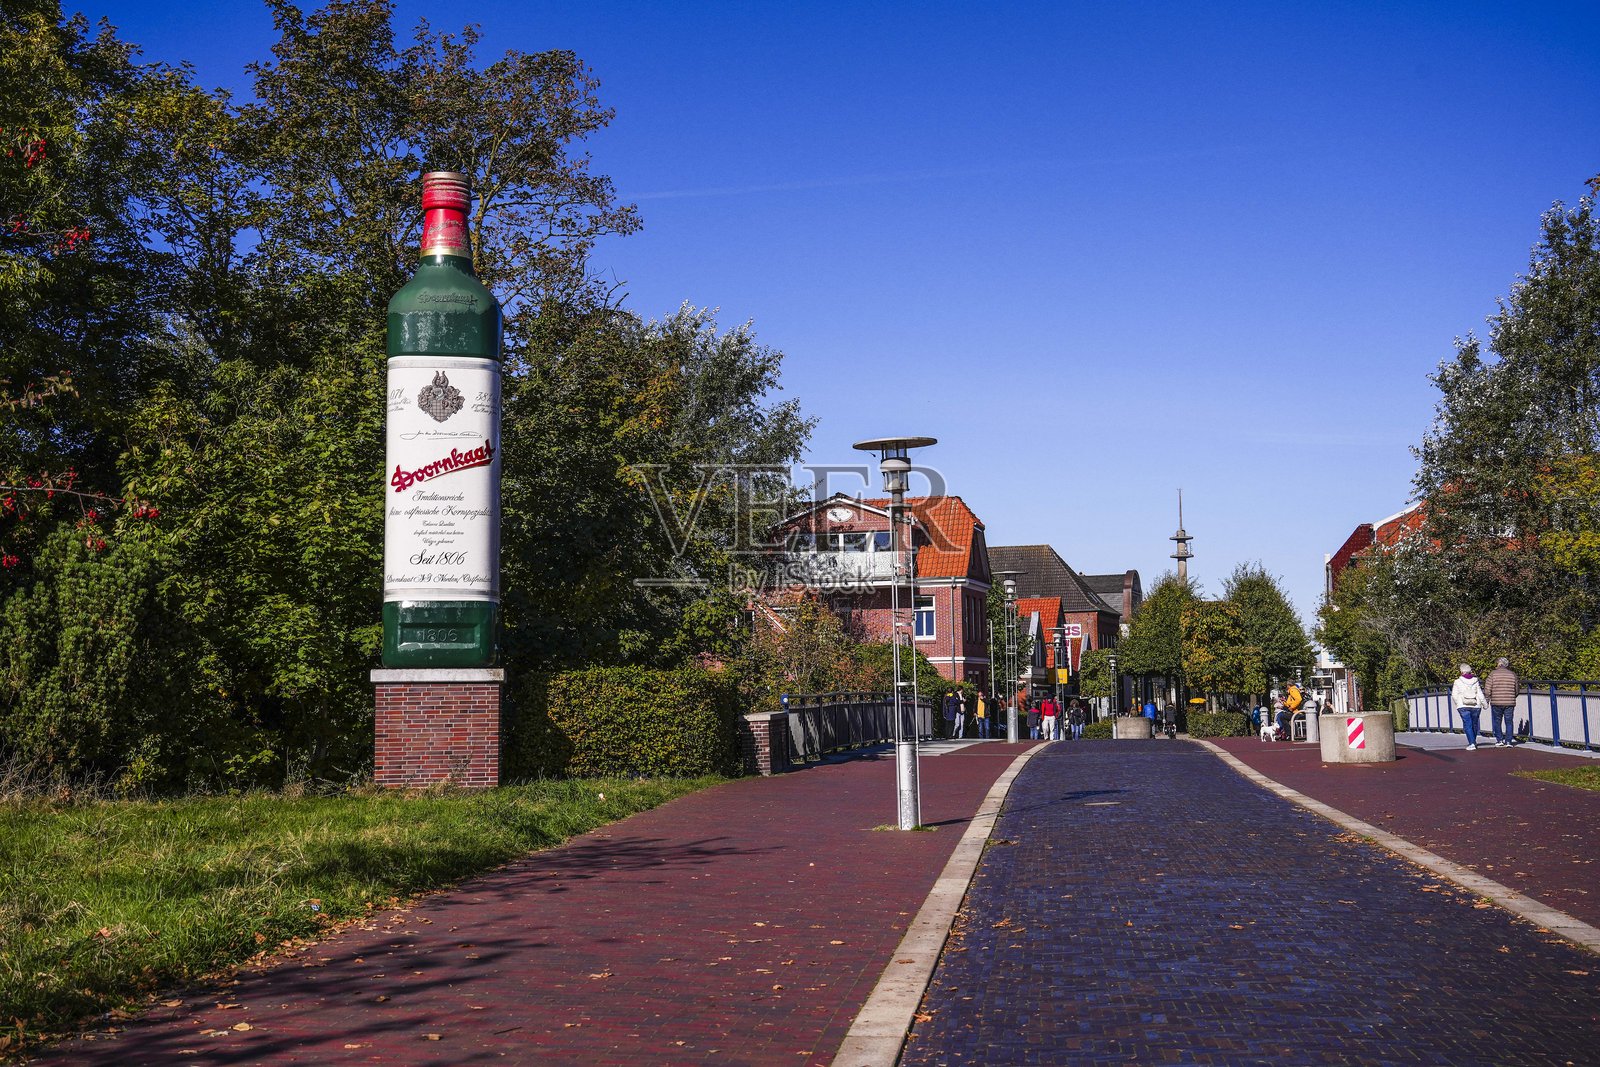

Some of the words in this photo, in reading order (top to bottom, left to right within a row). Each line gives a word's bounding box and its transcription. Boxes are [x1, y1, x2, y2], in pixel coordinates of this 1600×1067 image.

[391, 439, 495, 492] Doornkaat
[410, 549, 435, 566] Seit
[435, 551, 468, 566] 1806
[417, 628, 458, 642] 1806
